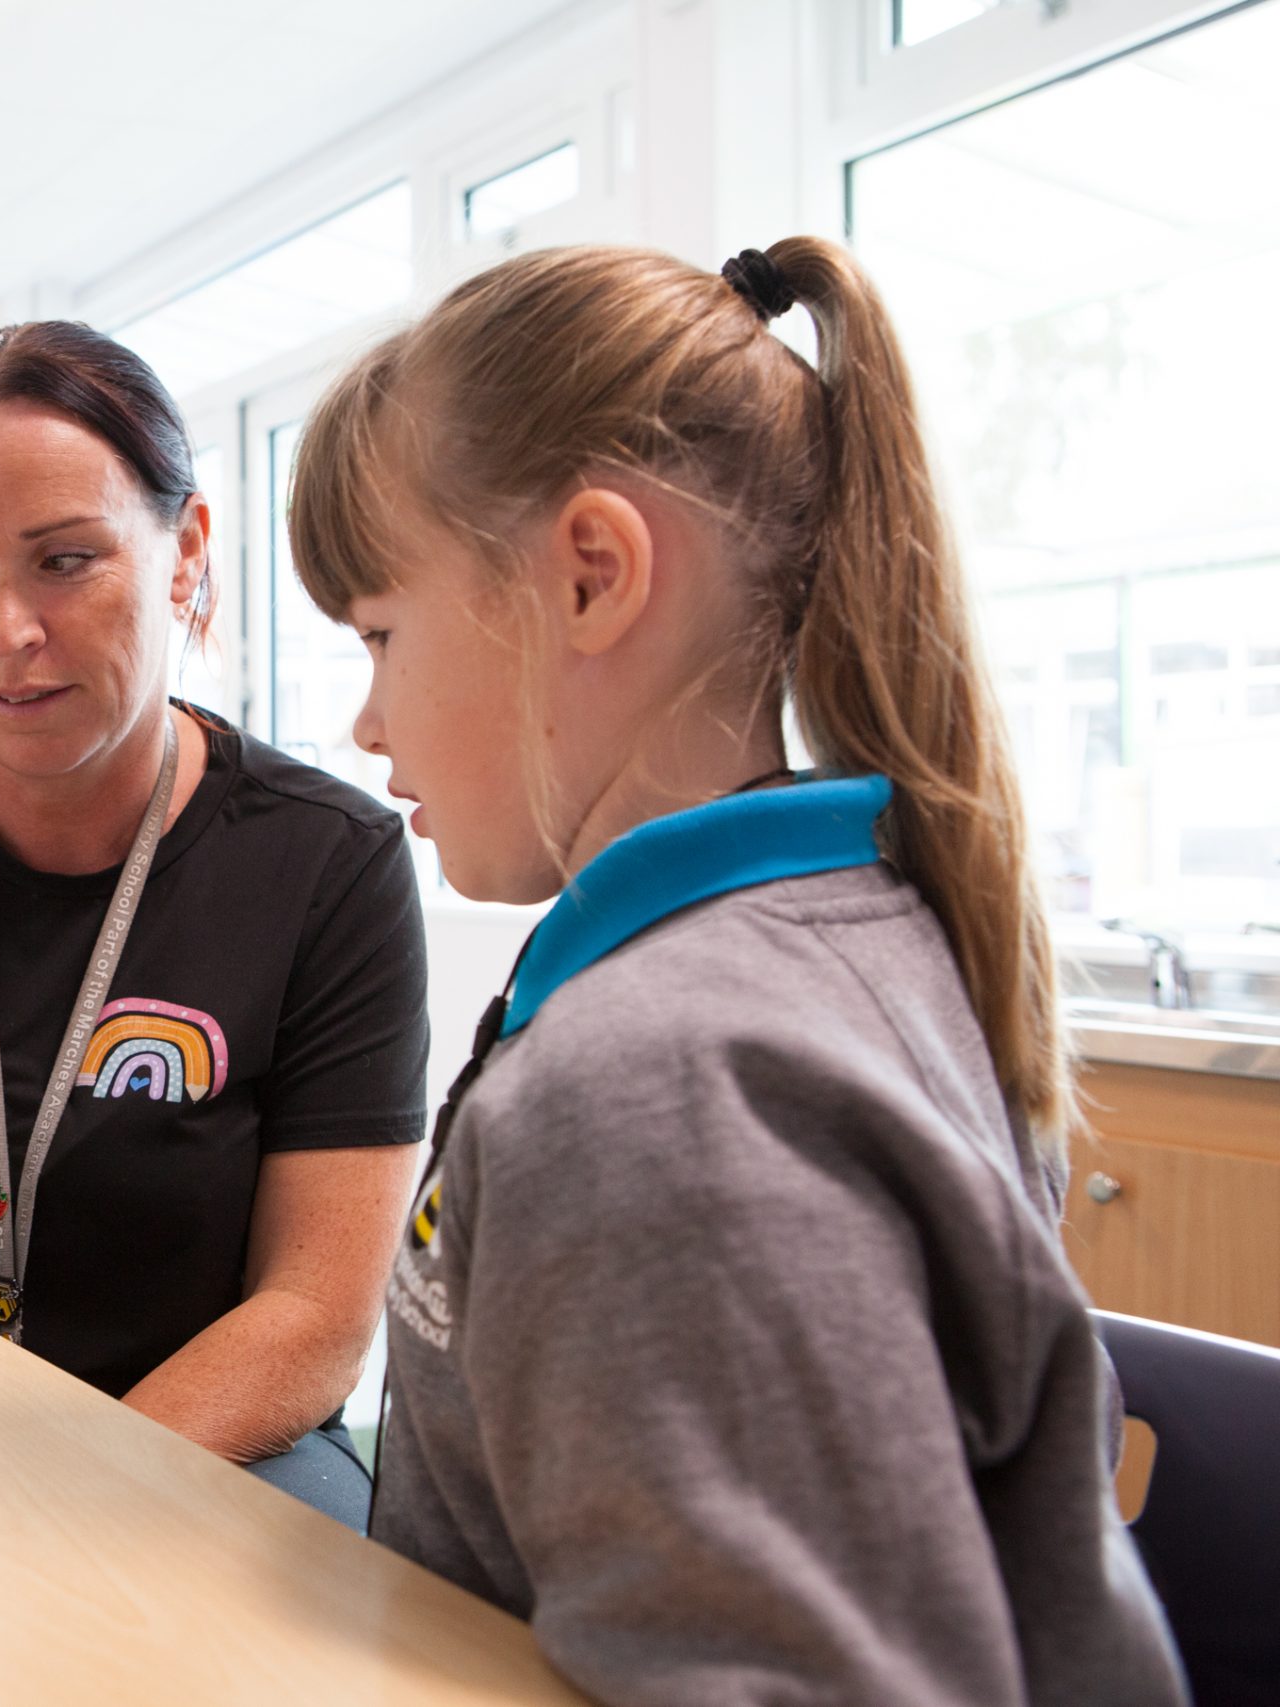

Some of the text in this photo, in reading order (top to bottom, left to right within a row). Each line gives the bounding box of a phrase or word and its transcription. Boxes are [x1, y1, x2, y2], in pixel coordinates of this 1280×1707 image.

[117, 853, 148, 916] School
[101, 918, 127, 956] Part
[95, 959, 109, 979] of
[83, 980, 104, 1009] the
[54, 1014, 94, 1092] Marches
